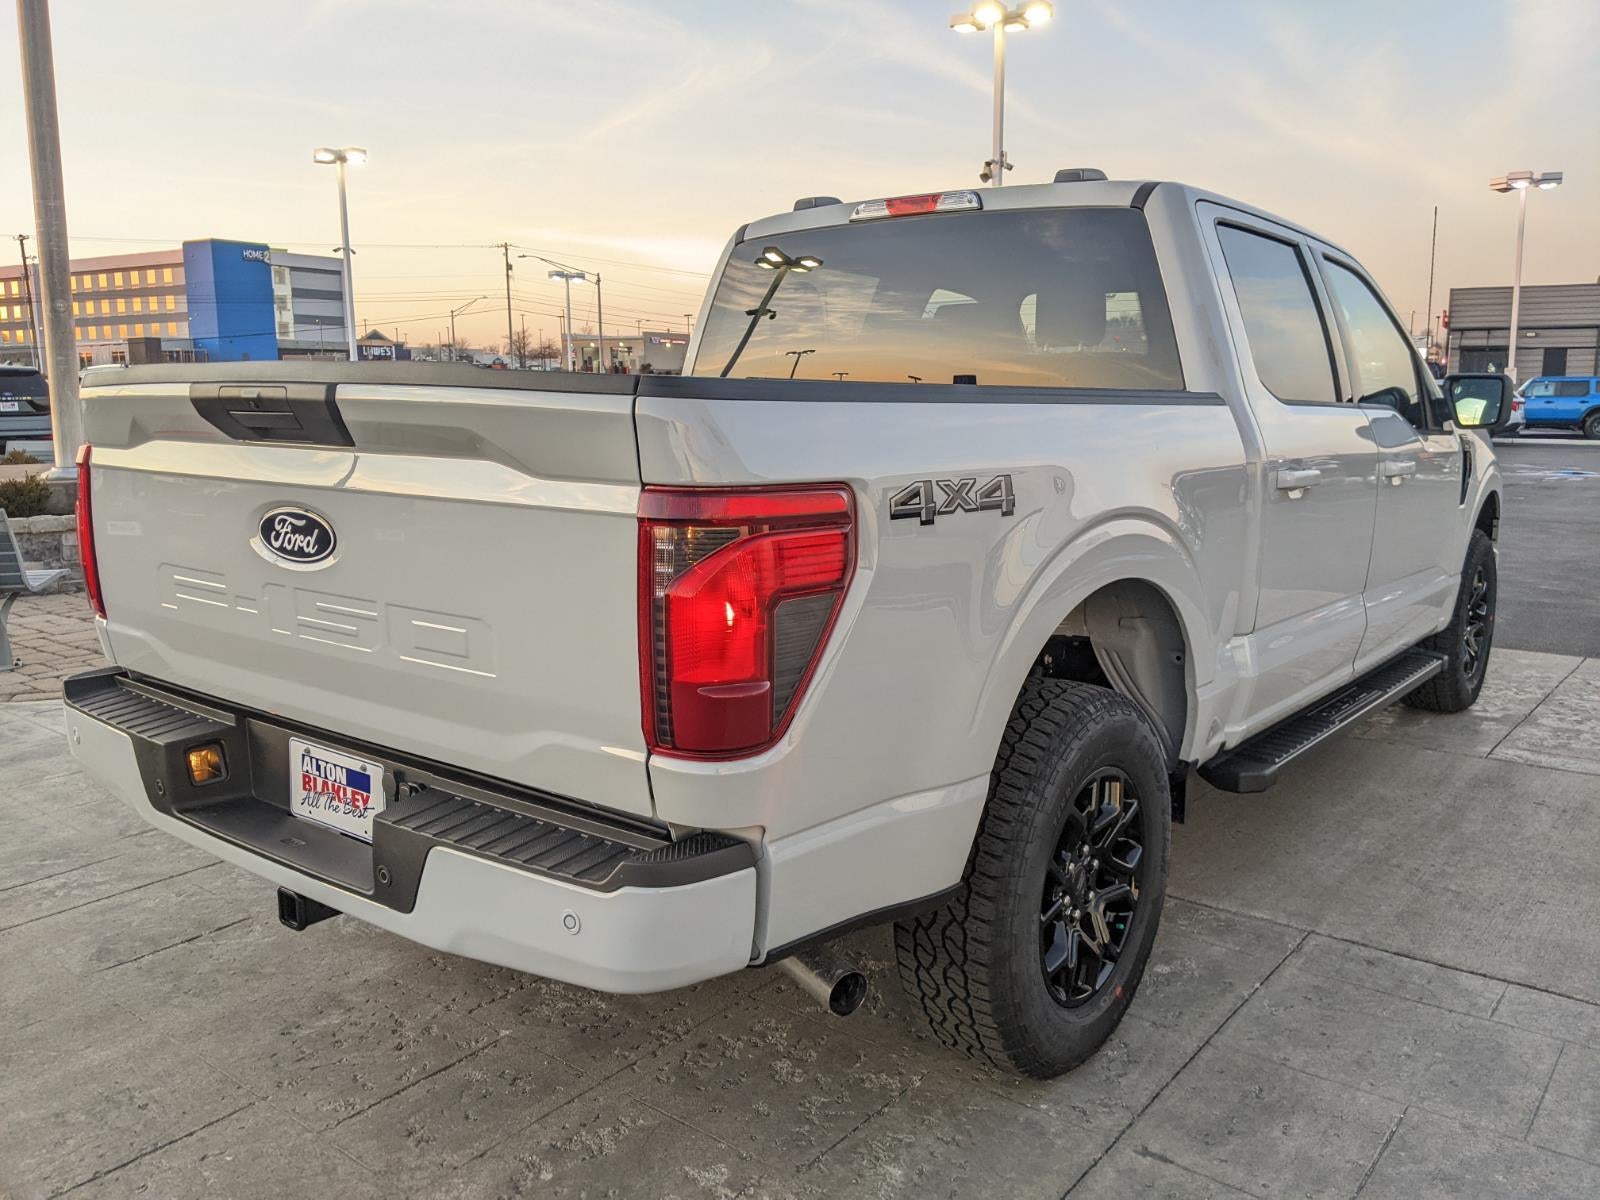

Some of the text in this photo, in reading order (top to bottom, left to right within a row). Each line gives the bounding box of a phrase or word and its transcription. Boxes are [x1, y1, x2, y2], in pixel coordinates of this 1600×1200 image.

[271, 515, 319, 554] Ford
[157, 562, 497, 678] F-150
[302, 755, 347, 785] ALTON
[301, 786, 375, 819] All The Best
[302, 772, 371, 810] BLAKLEY
